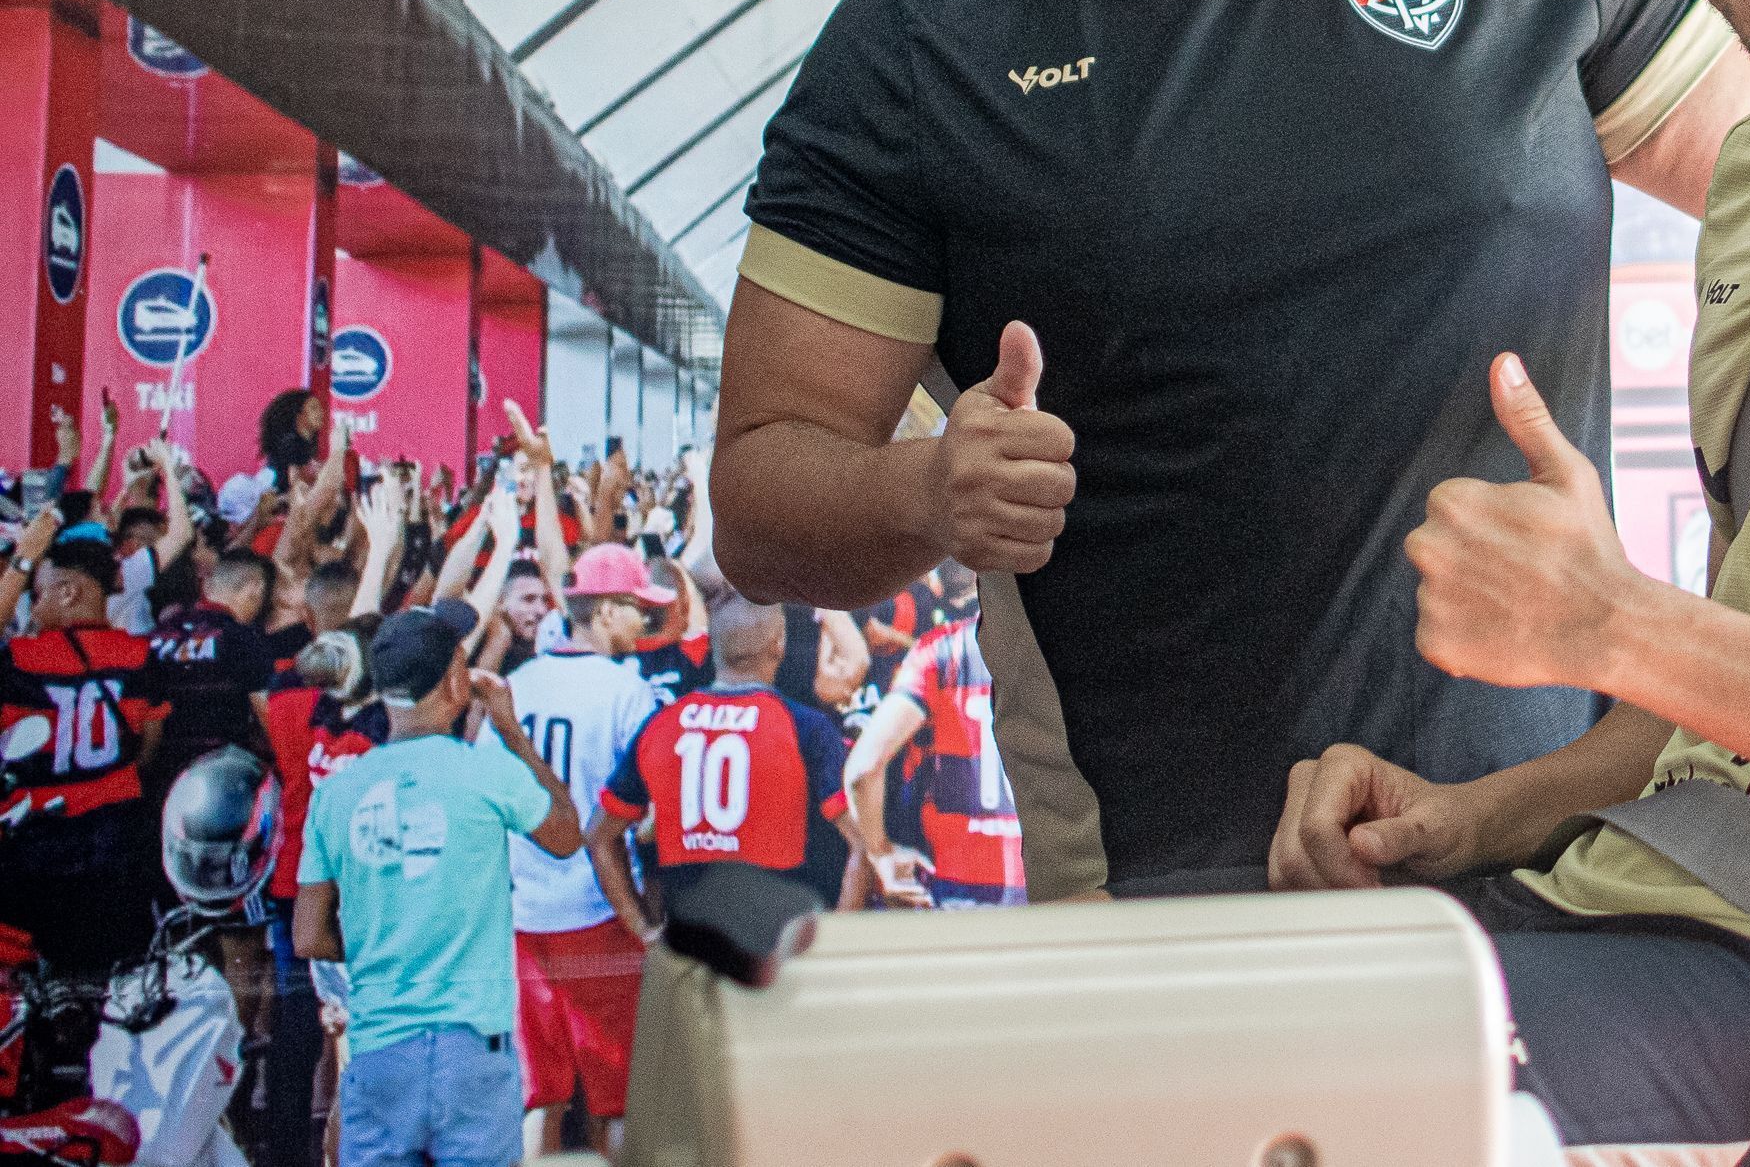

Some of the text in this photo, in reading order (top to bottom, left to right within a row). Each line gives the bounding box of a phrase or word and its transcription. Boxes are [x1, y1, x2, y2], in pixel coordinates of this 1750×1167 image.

[1007, 56, 1096, 95] VOLT
[1702, 278, 1741, 309] VOLT
[44, 680, 125, 774] 10
[679, 704, 760, 732] CAIXA
[674, 731, 750, 834] 10
